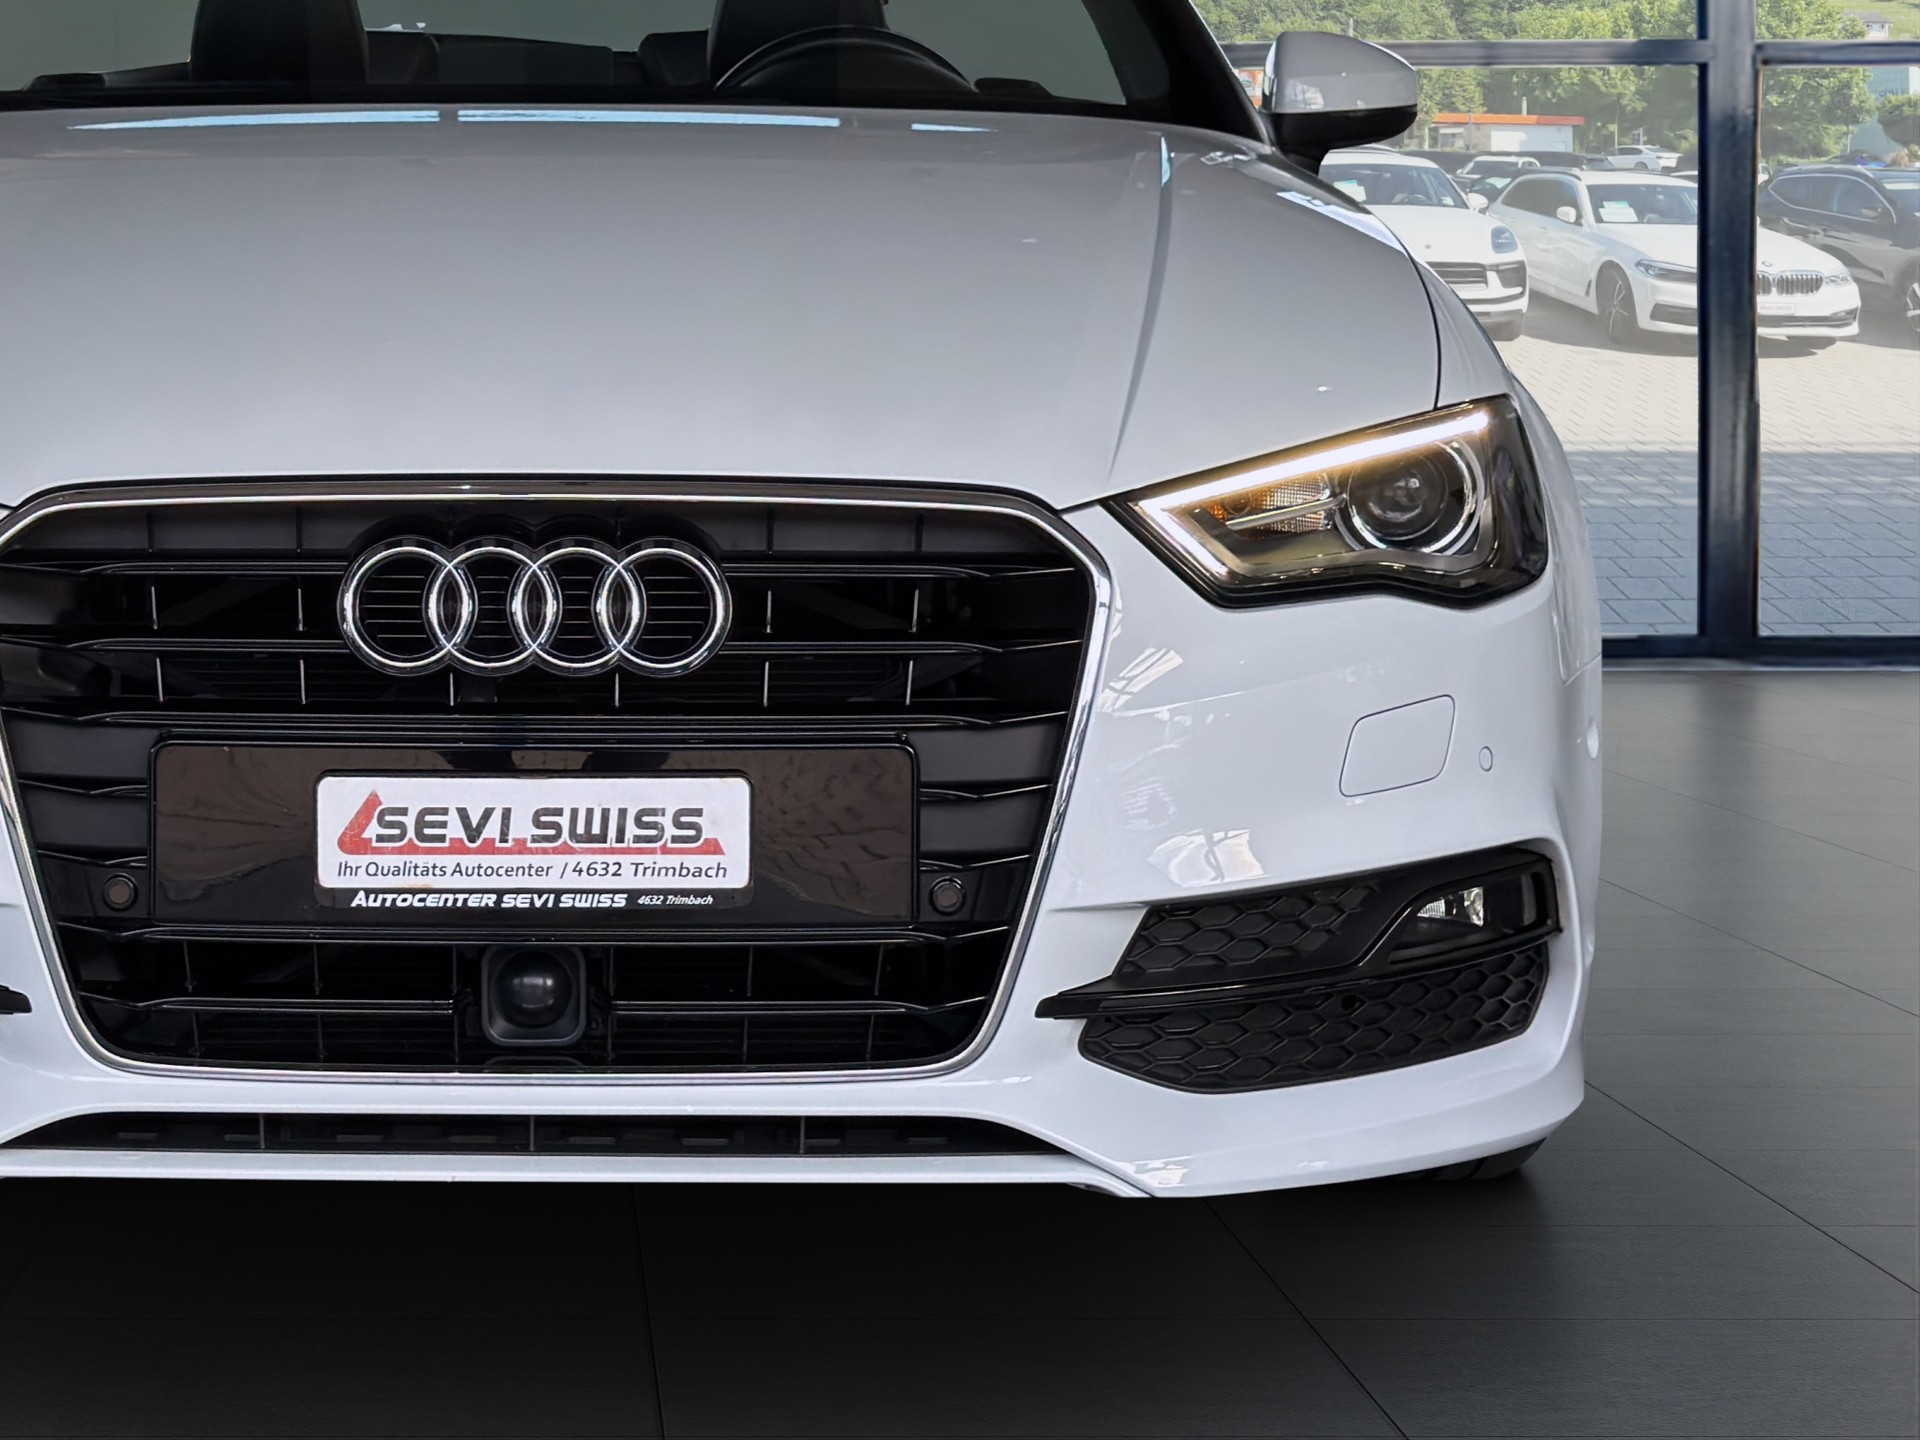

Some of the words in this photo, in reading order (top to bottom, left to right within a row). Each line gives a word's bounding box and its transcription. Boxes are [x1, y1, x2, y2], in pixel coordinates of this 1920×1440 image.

[375, 807, 513, 844] SEVI
[531, 807, 704, 844] SWISS
[337, 860, 362, 877] Ihr
[451, 861, 553, 878] Autocenter
[572, 861, 622, 877] 4632
[630, 861, 728, 878] Trimbach
[500, 893, 556, 908] SEVI
[559, 893, 629, 908] SWISS
[637, 894, 664, 905] 4632
[665, 894, 714, 906] Trimbach
